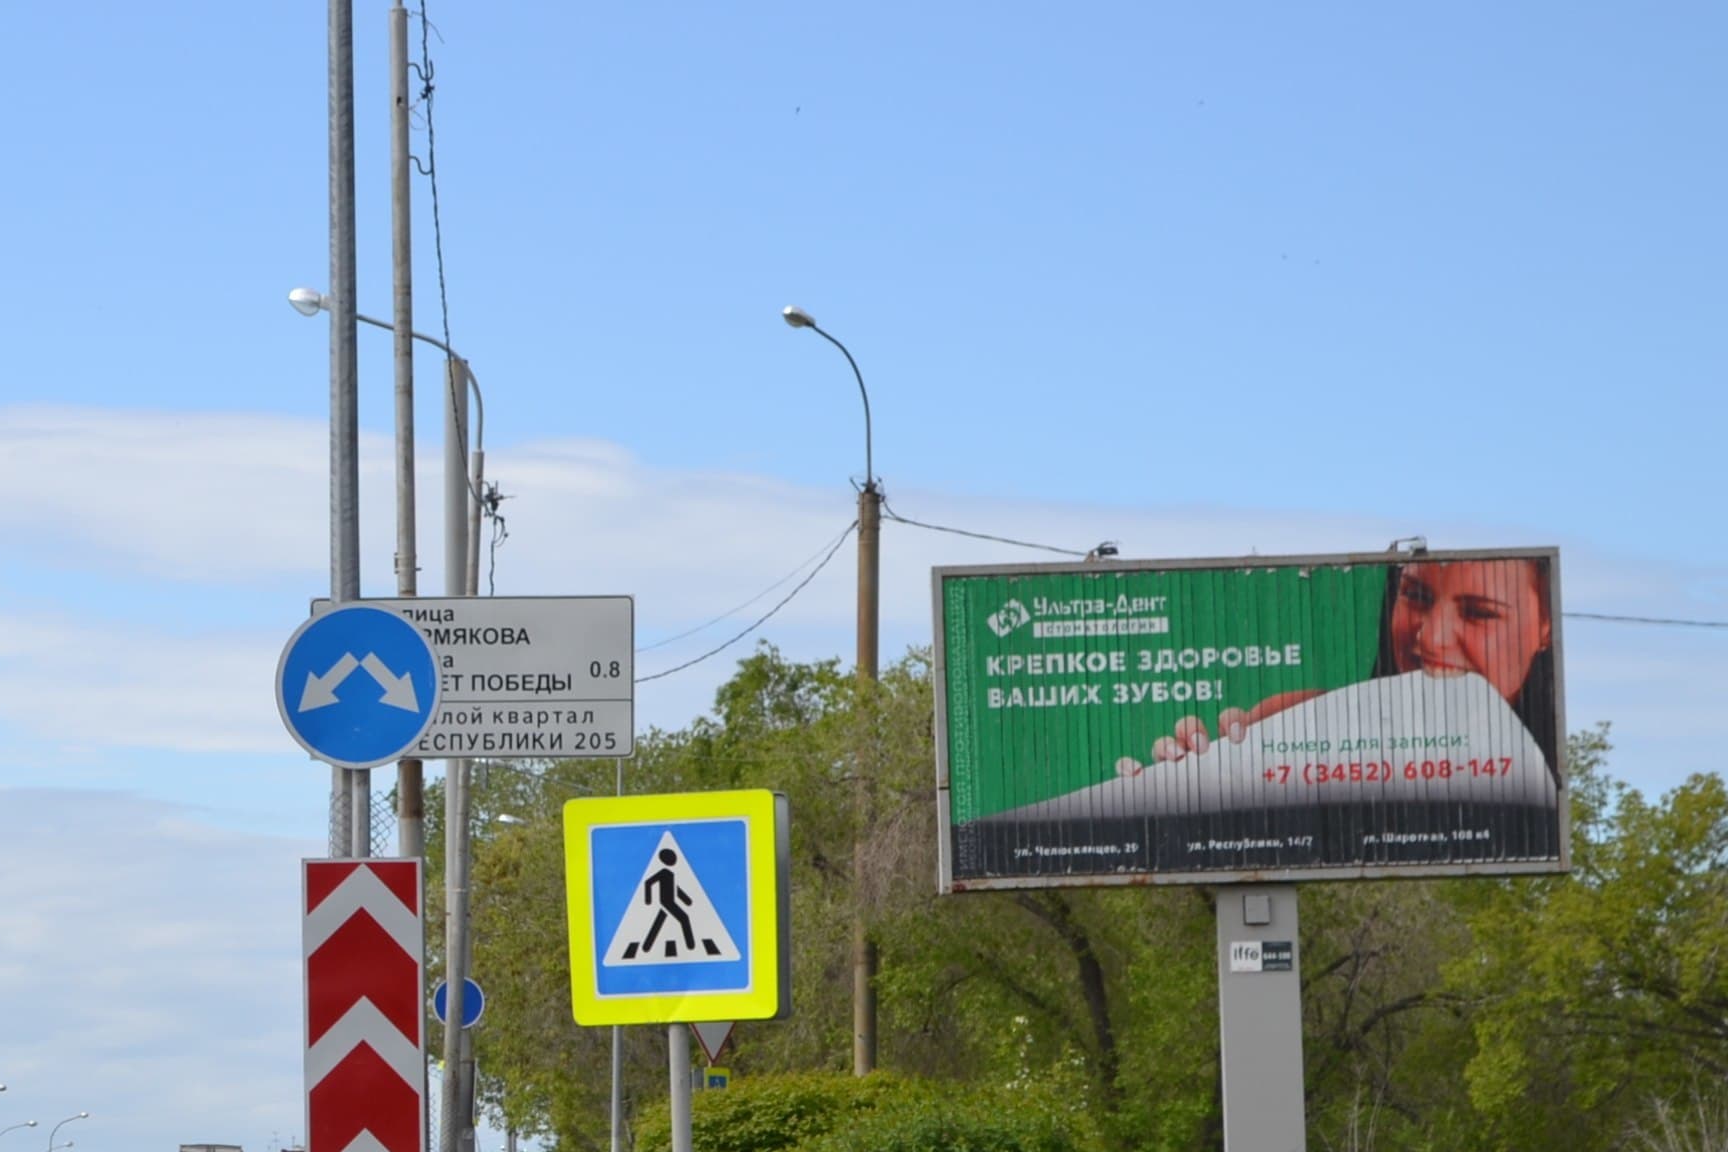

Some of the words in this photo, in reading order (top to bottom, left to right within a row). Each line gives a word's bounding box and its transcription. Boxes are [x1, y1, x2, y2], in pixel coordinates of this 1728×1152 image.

[402, 608, 454, 624] лица
[423, 627, 531, 646] МЯКОВА
[589, 661, 621, 679] 0.8
[987, 651, 1126, 676] КРЕПКОЕ
[1137, 645, 1302, 673] ЗДОРОВЬЕ
[472, 674, 572, 694] ПОБЕДЫ
[987, 684, 1103, 708] ВАШИХ
[1112, 679, 1224, 704] ЗУБОВ!
[433, 706, 483, 725] лой
[492, 708, 595, 727] квартал
[418, 732, 564, 751] ЕСПУБЛИКИ
[574, 731, 618, 750] 205
[1262, 739, 1331, 754] Номер
[1338, 737, 1380, 752] для
[1262, 765, 1292, 785] +7
[1303, 760, 1393, 785] (3452)
[1403, 757, 1513, 780] 608-147
